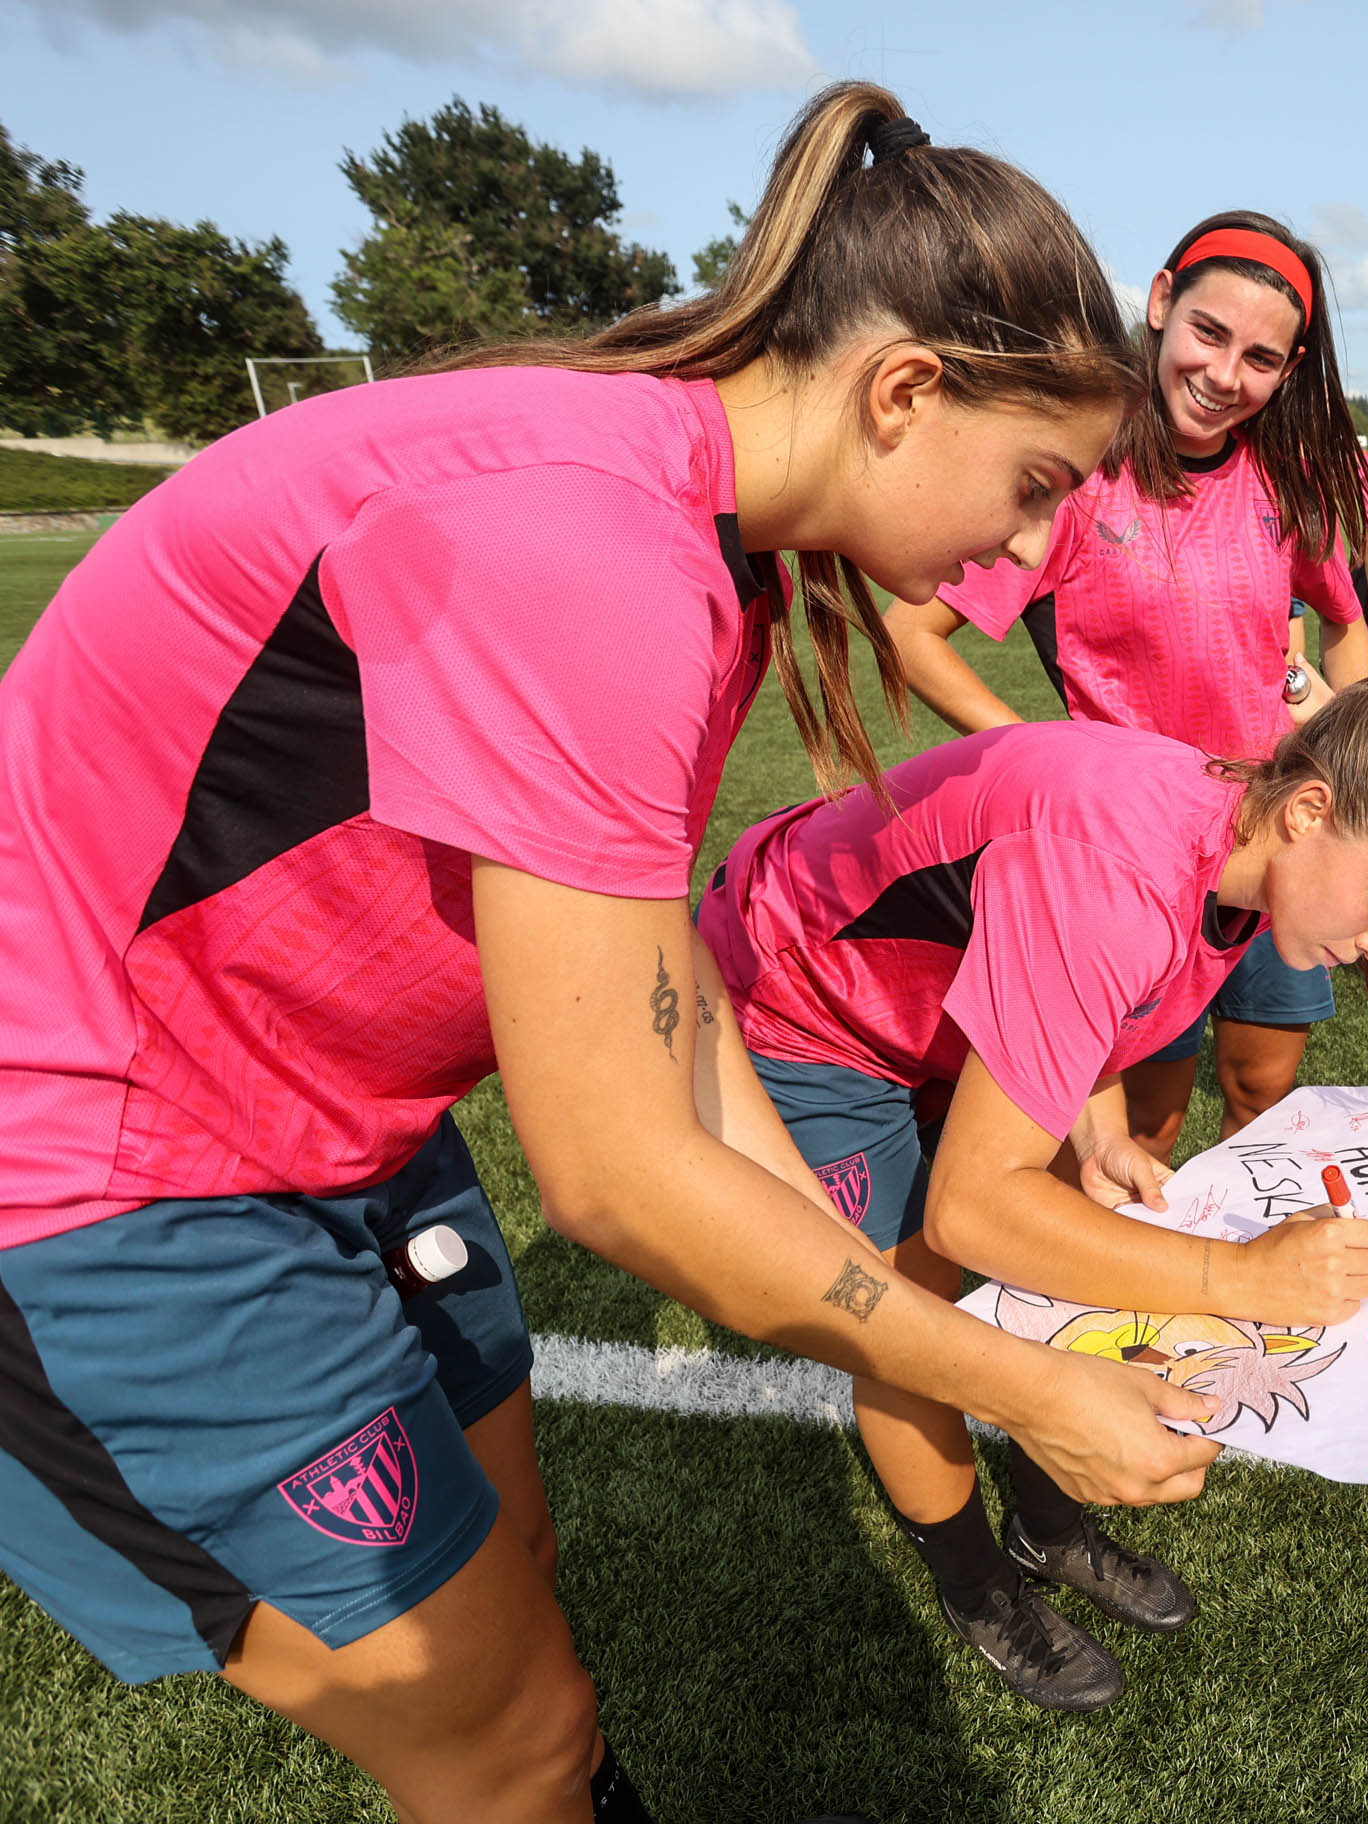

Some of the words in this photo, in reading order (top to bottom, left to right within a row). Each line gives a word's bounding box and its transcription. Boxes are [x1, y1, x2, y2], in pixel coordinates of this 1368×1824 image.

[291, 1441, 359, 1490] ATHLETIC
[359, 1415, 391, 1444] CLUB
[361, 1496, 411, 1541] BILBAO
